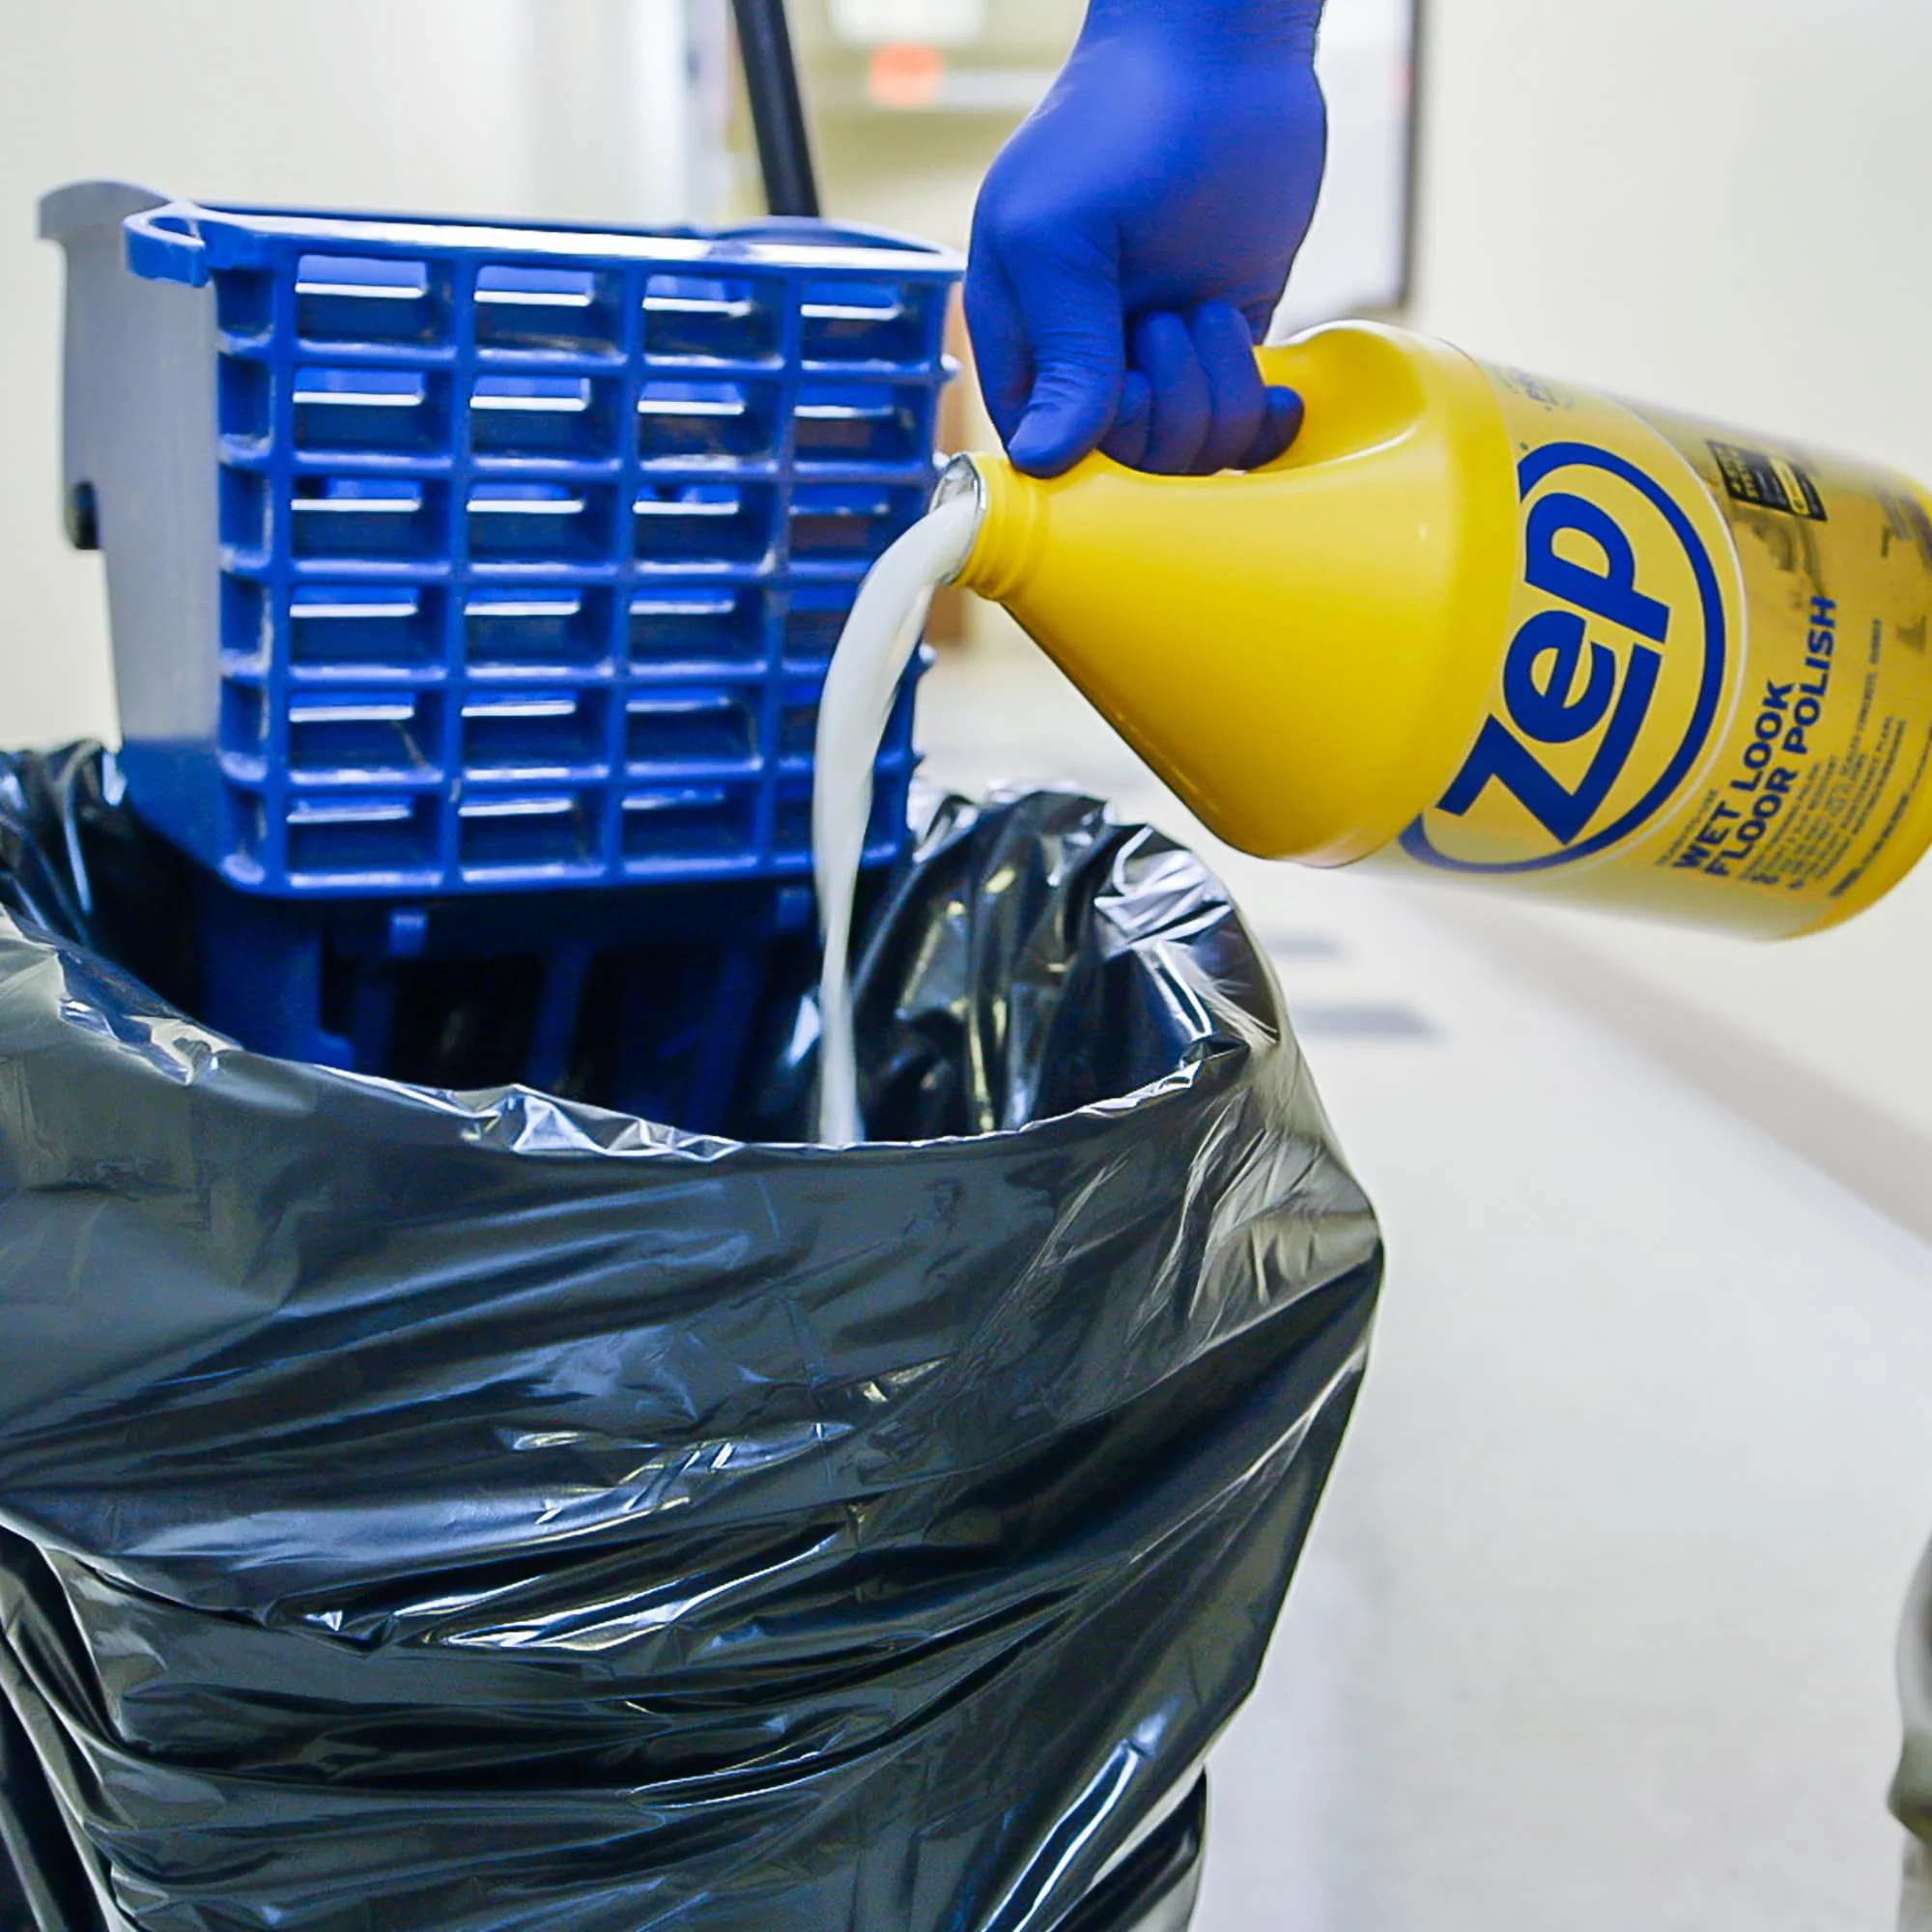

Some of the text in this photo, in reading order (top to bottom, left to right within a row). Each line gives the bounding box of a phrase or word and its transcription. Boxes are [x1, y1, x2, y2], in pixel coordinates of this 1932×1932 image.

[1672, 800, 1741, 868] WET
[1729, 679, 1795, 792] LOOK
[1702, 766, 1799, 877] FLOOR
[1781, 595, 1837, 755] POLISH
